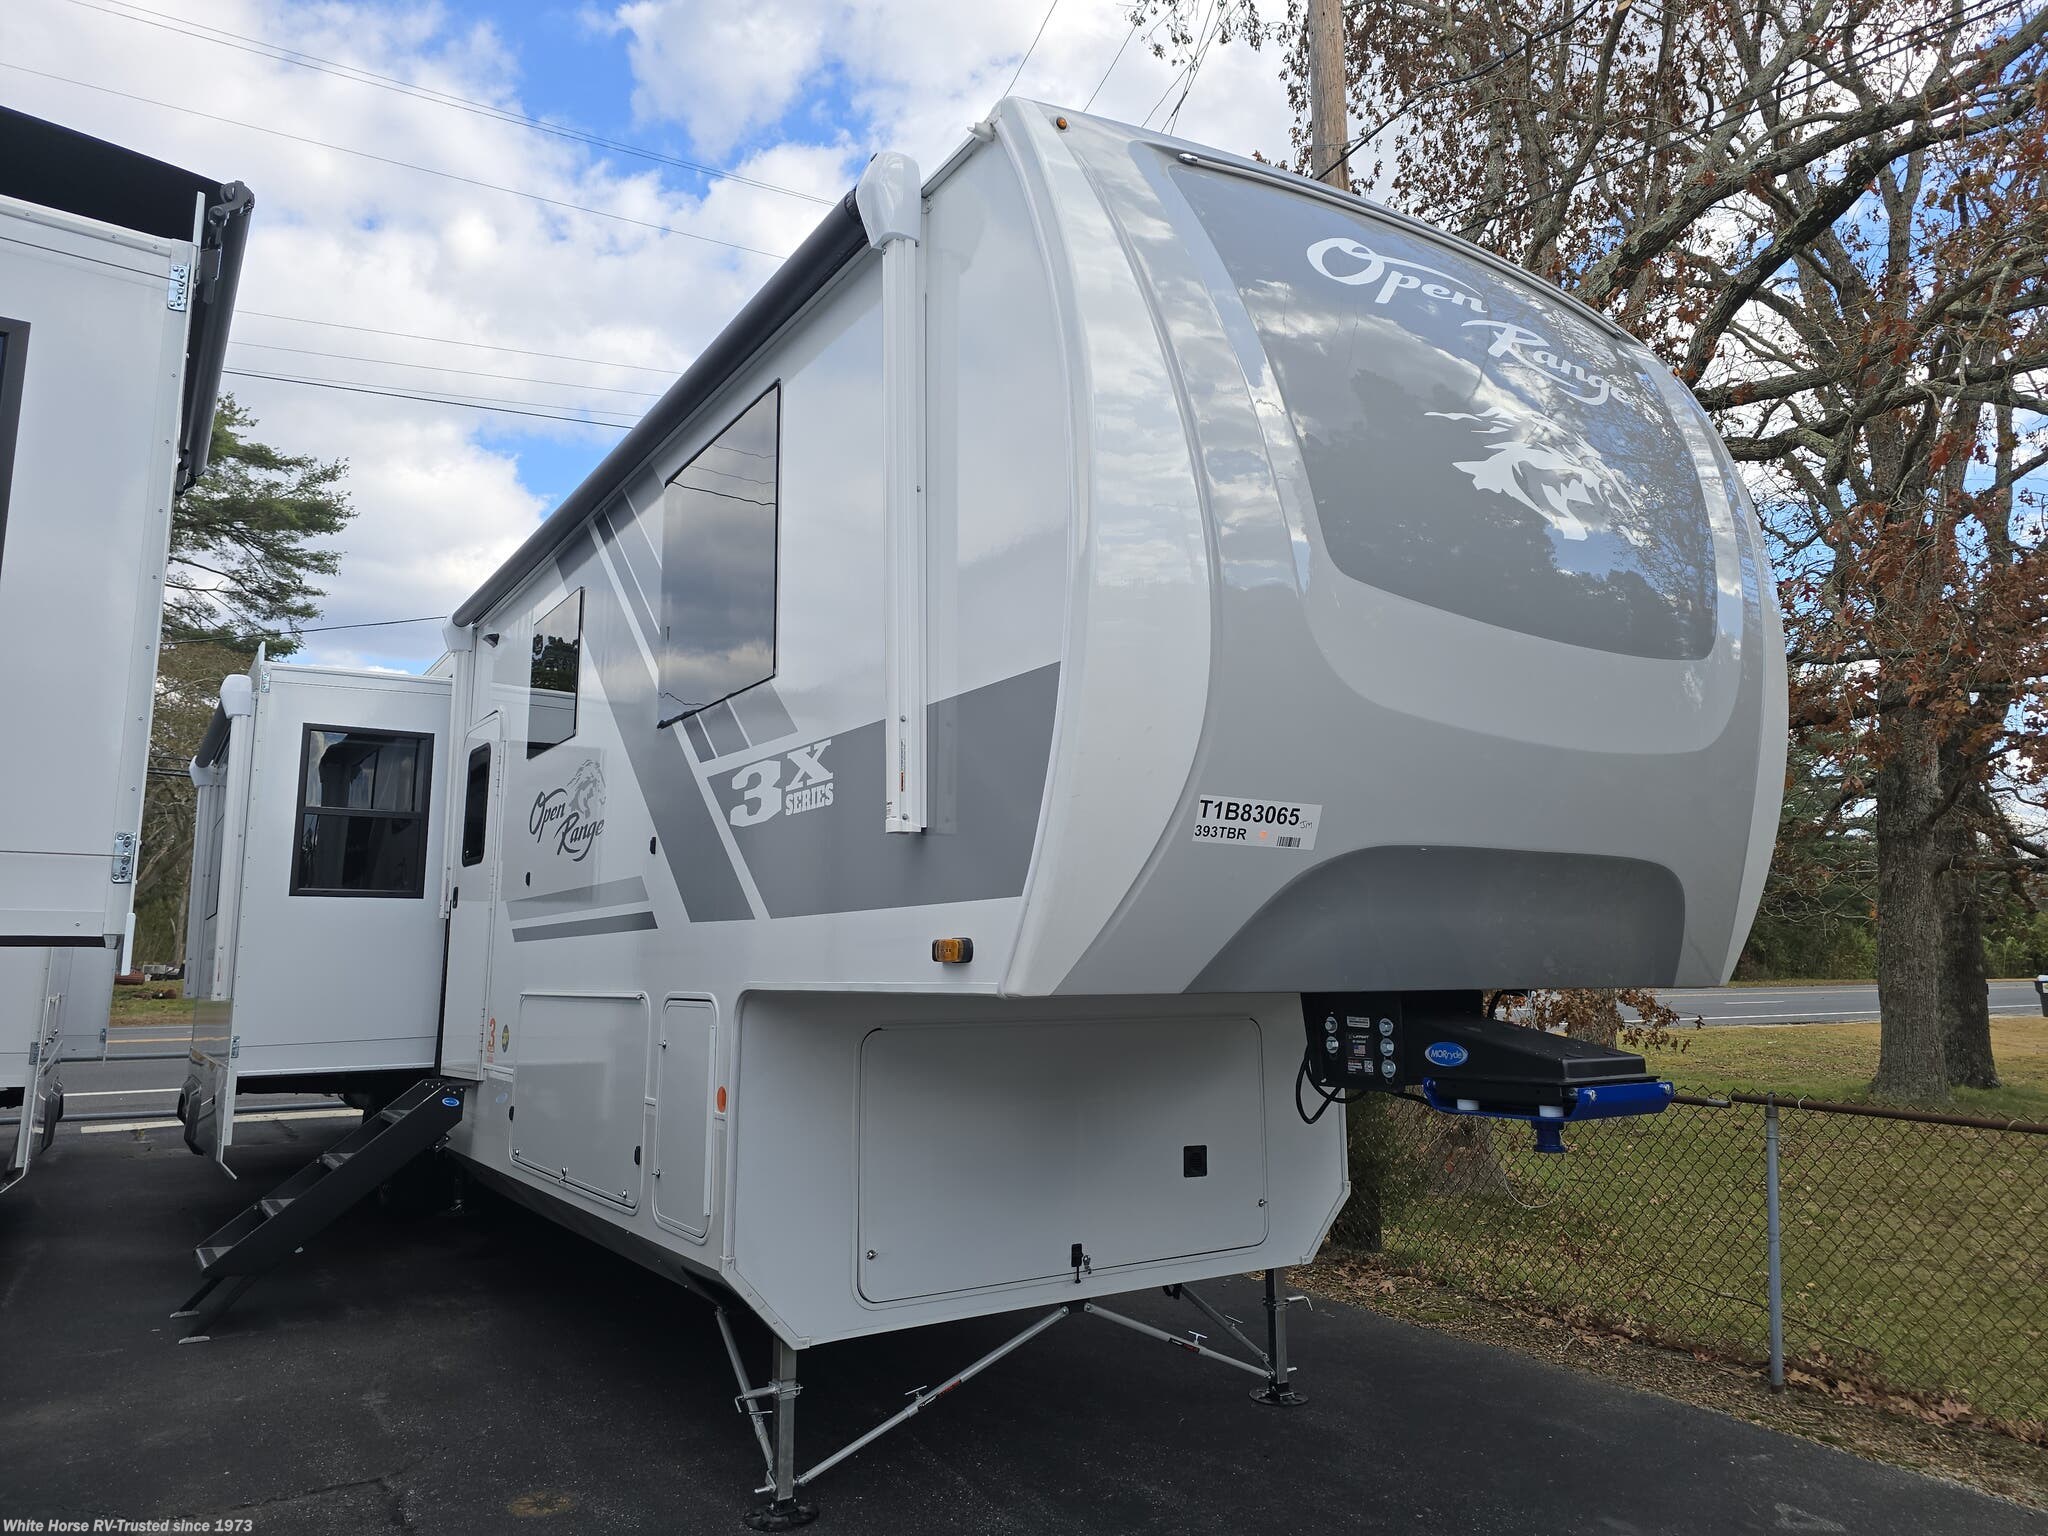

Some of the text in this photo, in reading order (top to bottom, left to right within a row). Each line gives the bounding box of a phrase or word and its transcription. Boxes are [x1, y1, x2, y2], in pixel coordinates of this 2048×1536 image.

[1306, 237, 1488, 314] Open
[1461, 319, 1634, 406] Range
[529, 787, 568, 844] Open
[785, 782, 834, 816] SERIES
[1200, 799, 1300, 826] T1B83065
[553, 812, 605, 862] Range
[1194, 824, 1247, 840] 393TBR
